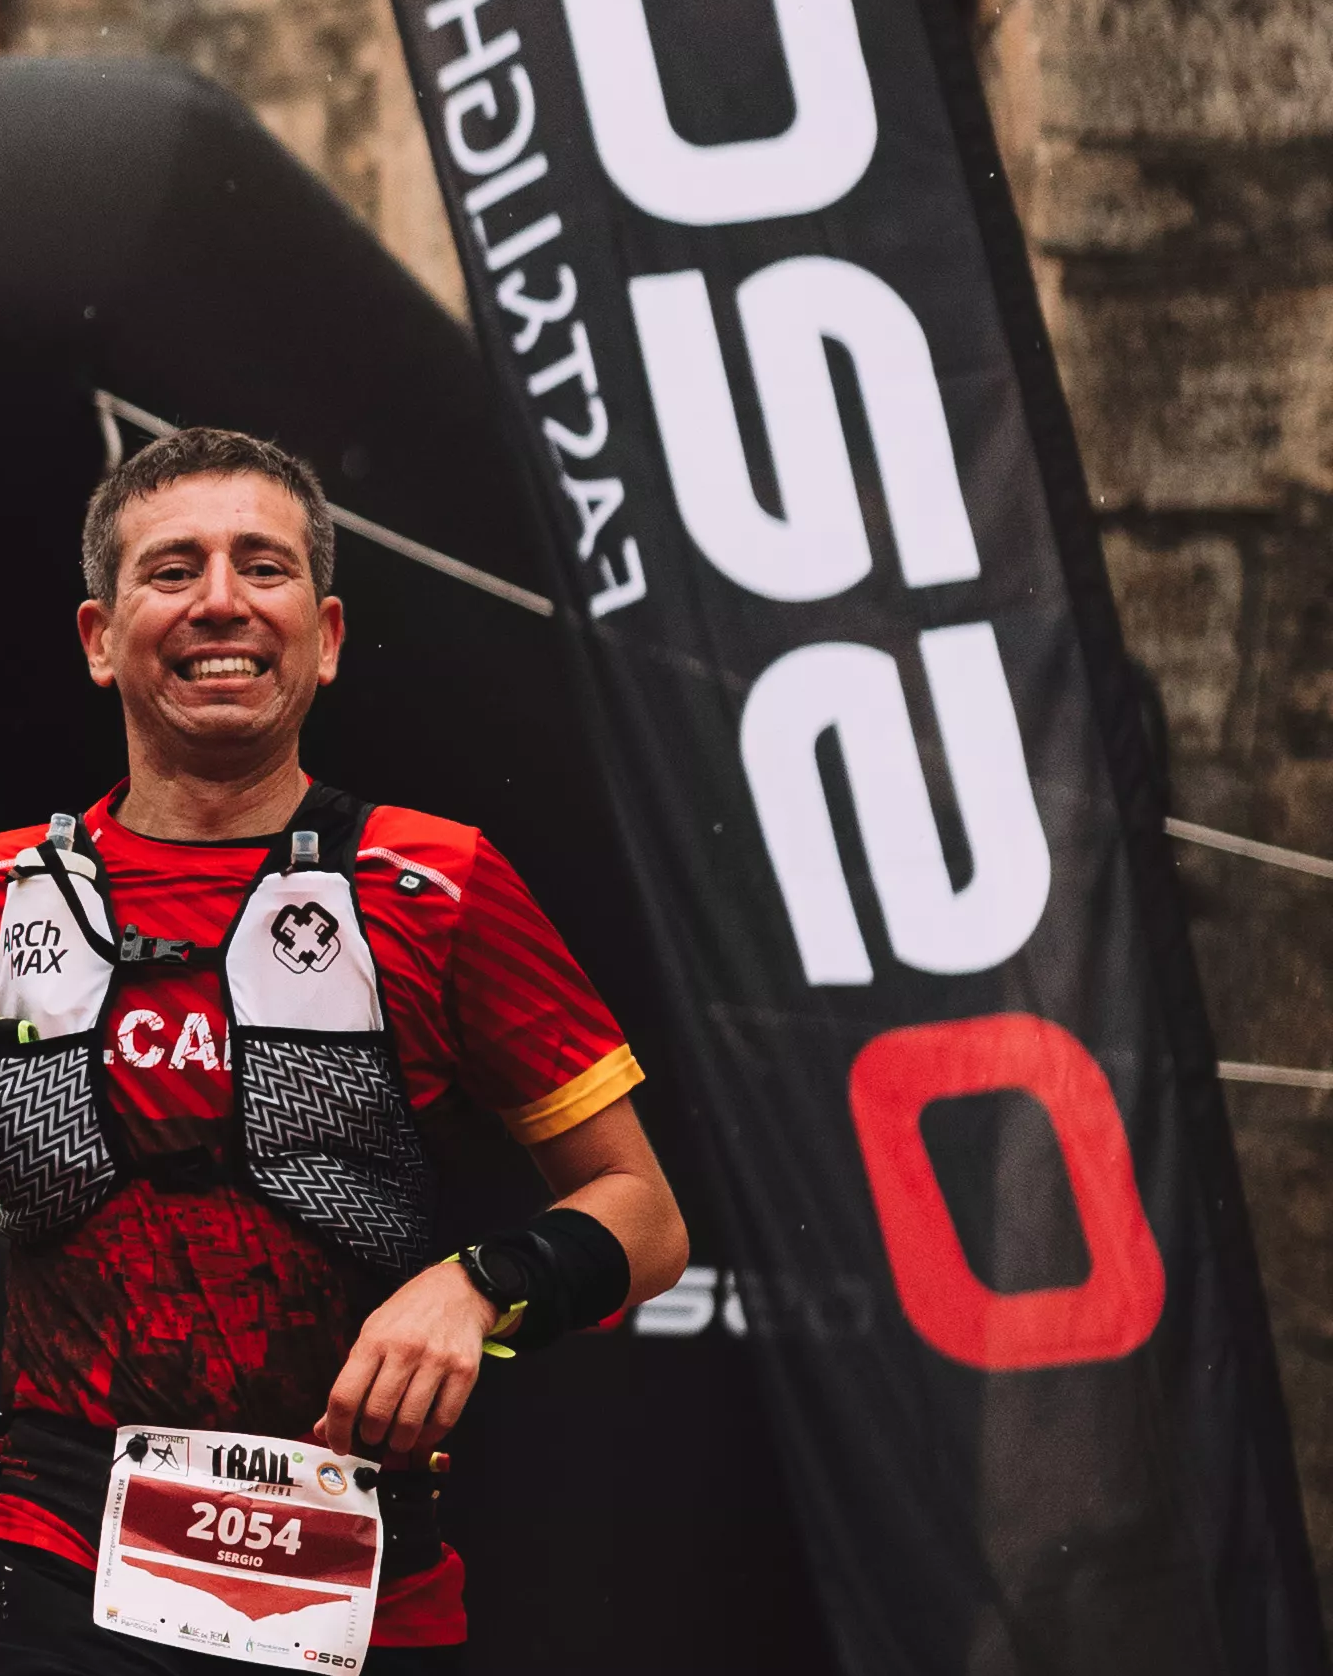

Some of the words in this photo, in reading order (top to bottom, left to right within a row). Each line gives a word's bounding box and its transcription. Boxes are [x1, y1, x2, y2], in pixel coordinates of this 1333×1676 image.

[10, 949, 69, 980] MAX
[206, 1443, 294, 1486] TRAIL
[264, 1485, 291, 1496] TENA
[186, 1501, 302, 1555] 2054
[216, 1550, 264, 1567] SERGIO
